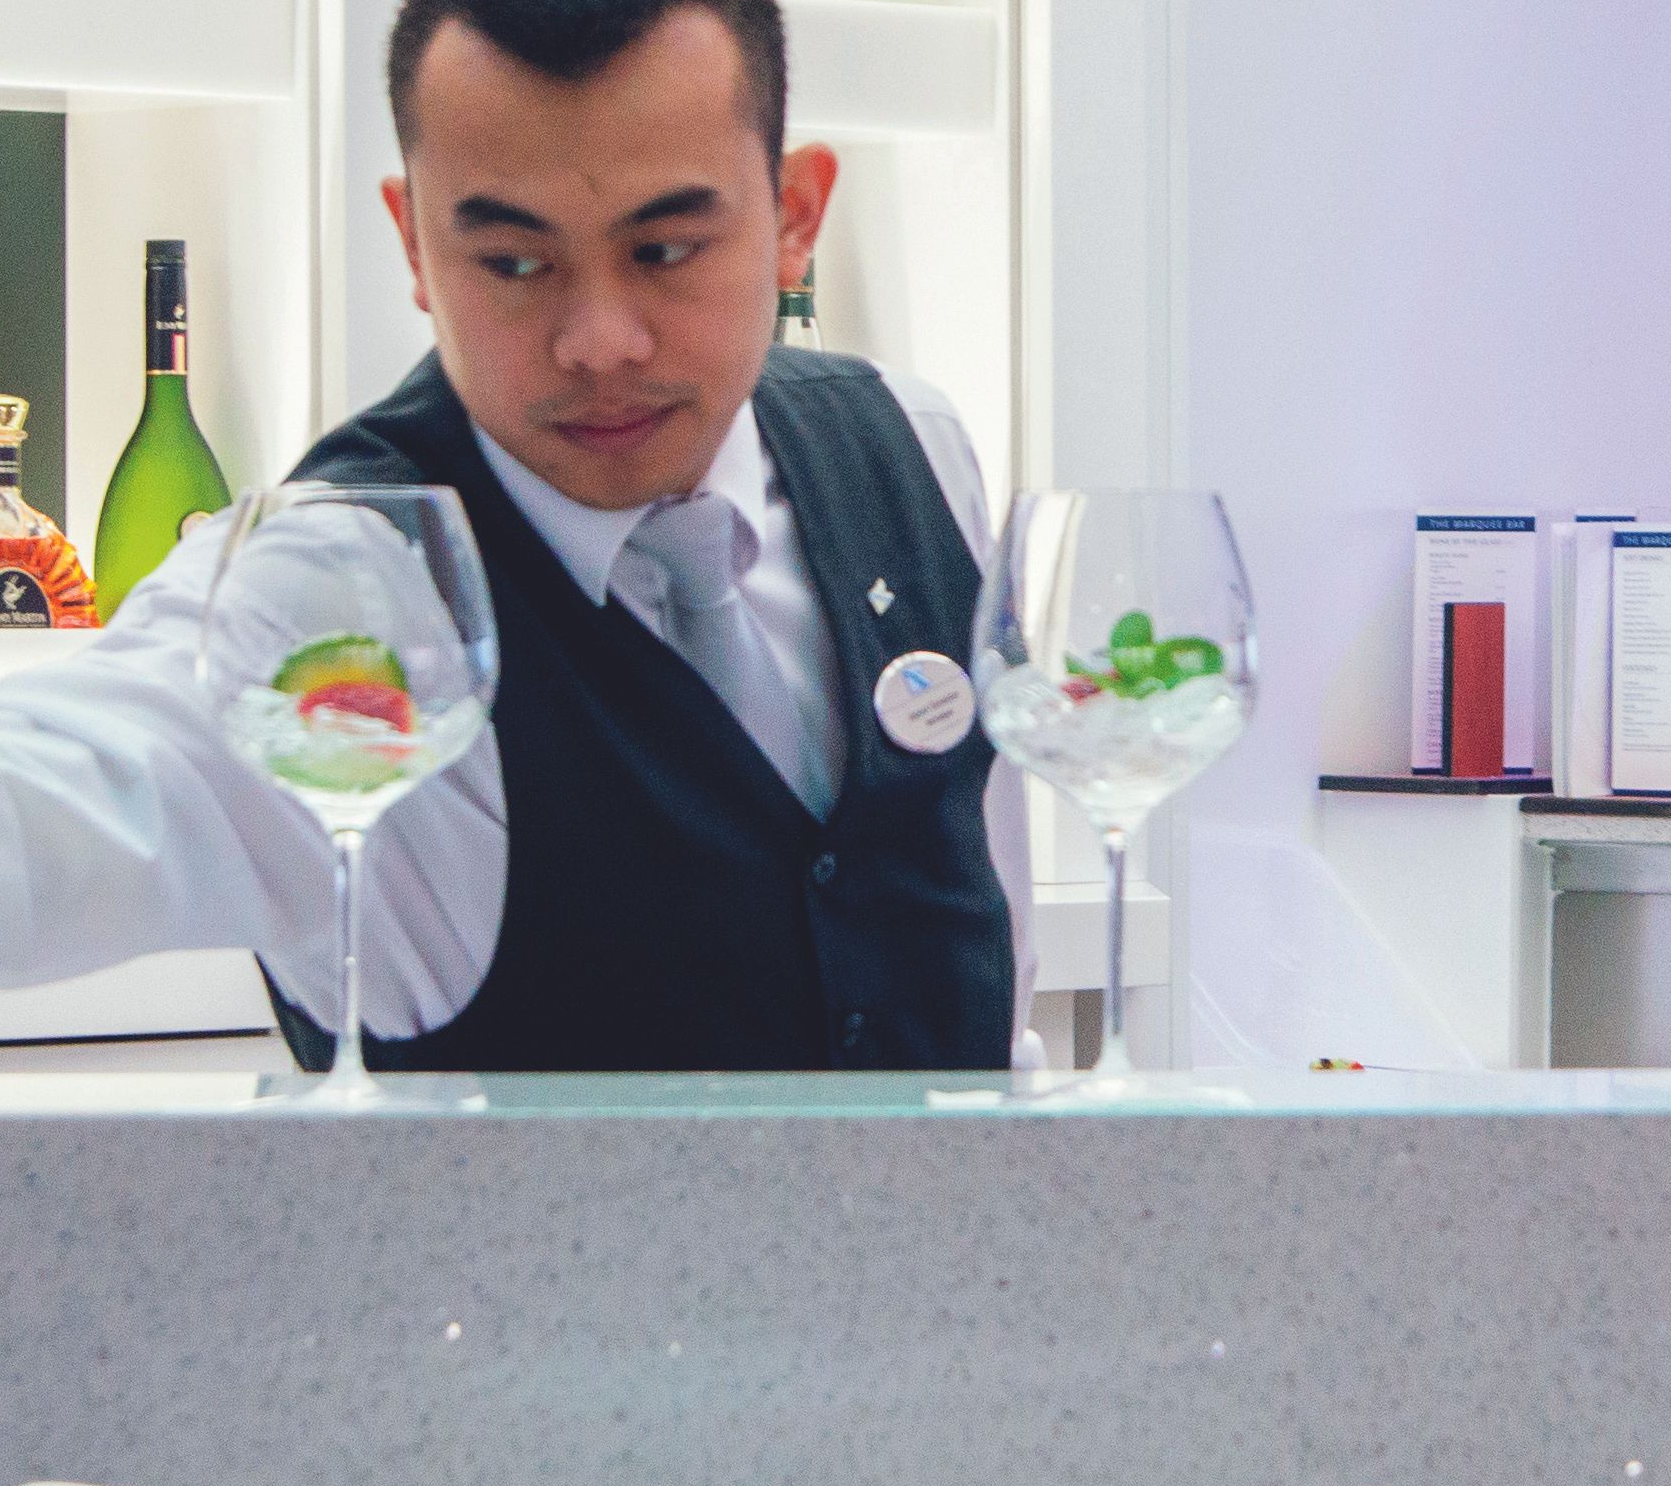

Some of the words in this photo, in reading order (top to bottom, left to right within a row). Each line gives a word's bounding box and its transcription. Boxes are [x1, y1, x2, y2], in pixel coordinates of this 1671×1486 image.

[1430, 519, 1450, 528] THE
[1453, 519, 1502, 529] MARQUEE
[1506, 520, 1526, 528] BAR
[1623, 536, 1639, 545] THE
